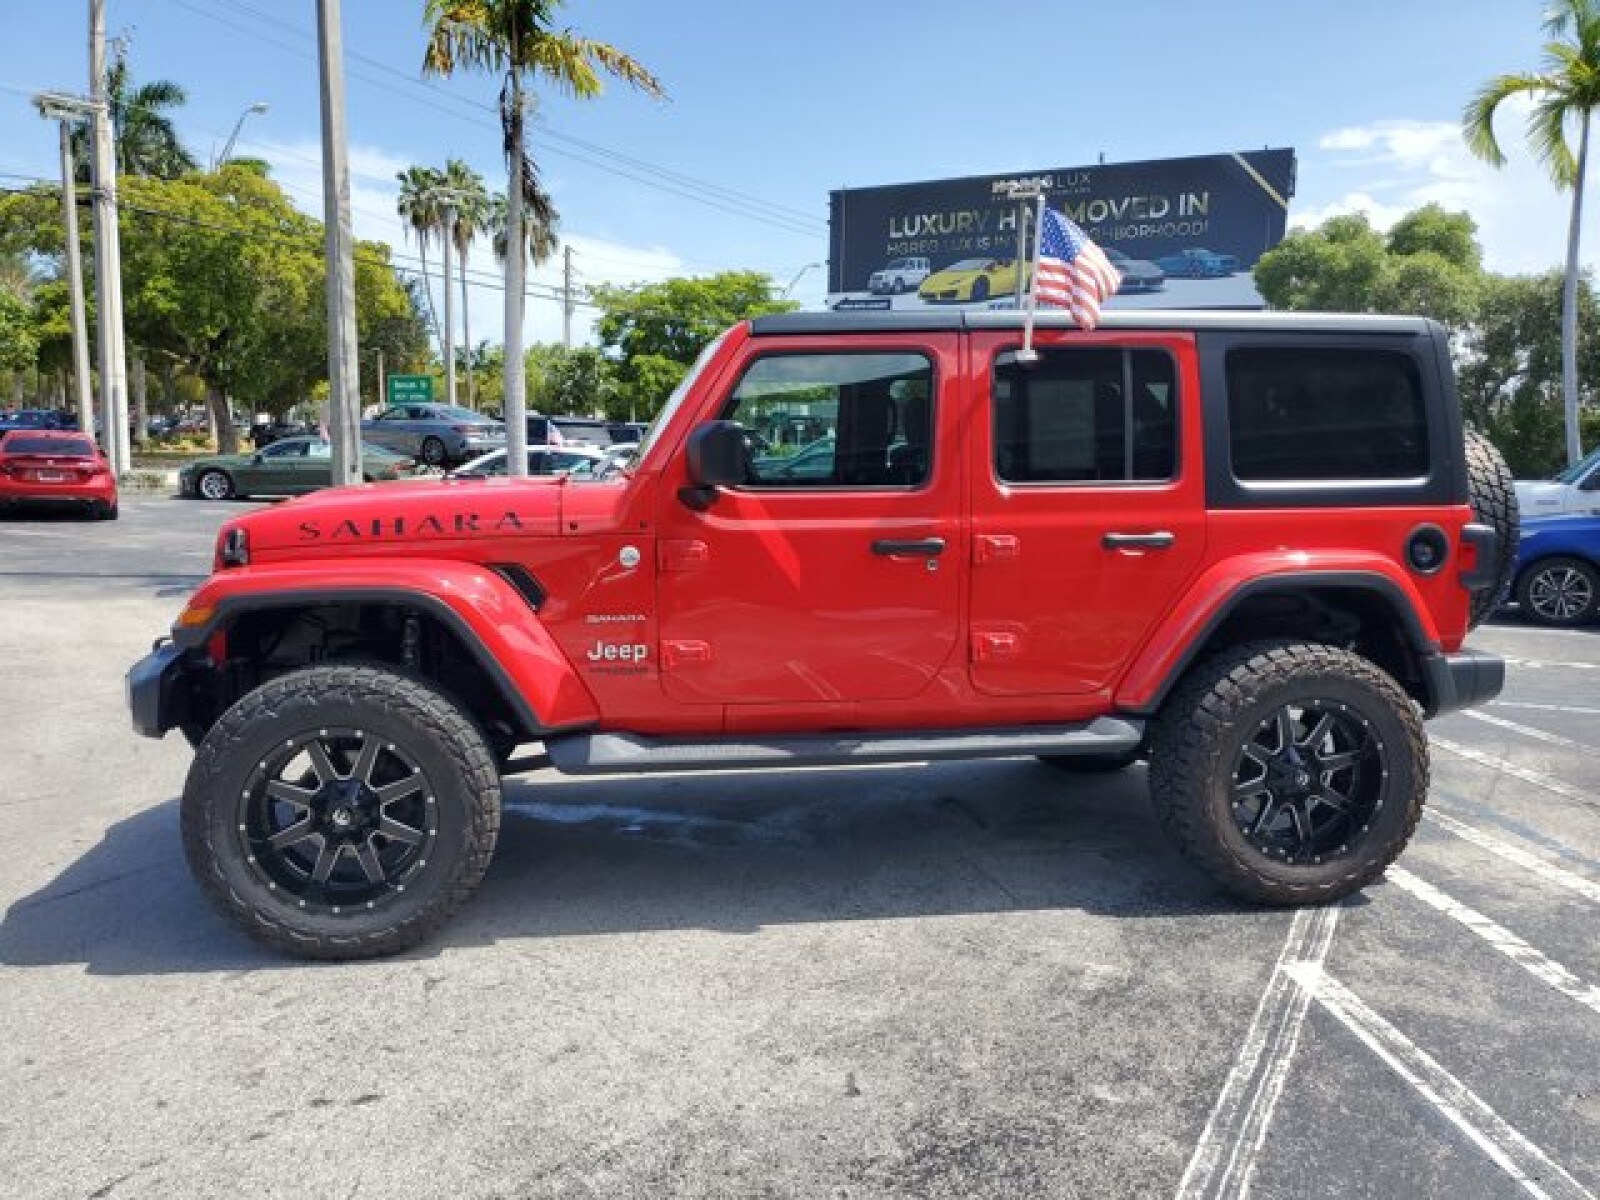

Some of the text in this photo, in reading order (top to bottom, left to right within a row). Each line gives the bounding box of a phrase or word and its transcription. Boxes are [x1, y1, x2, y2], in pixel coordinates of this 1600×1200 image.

[889, 209, 990, 239] LUXURY
[1063, 193, 1170, 224] MOVED
[1179, 191, 1209, 217] IN
[298, 510, 524, 540] SAHARA
[586, 639, 648, 664] Jeep
